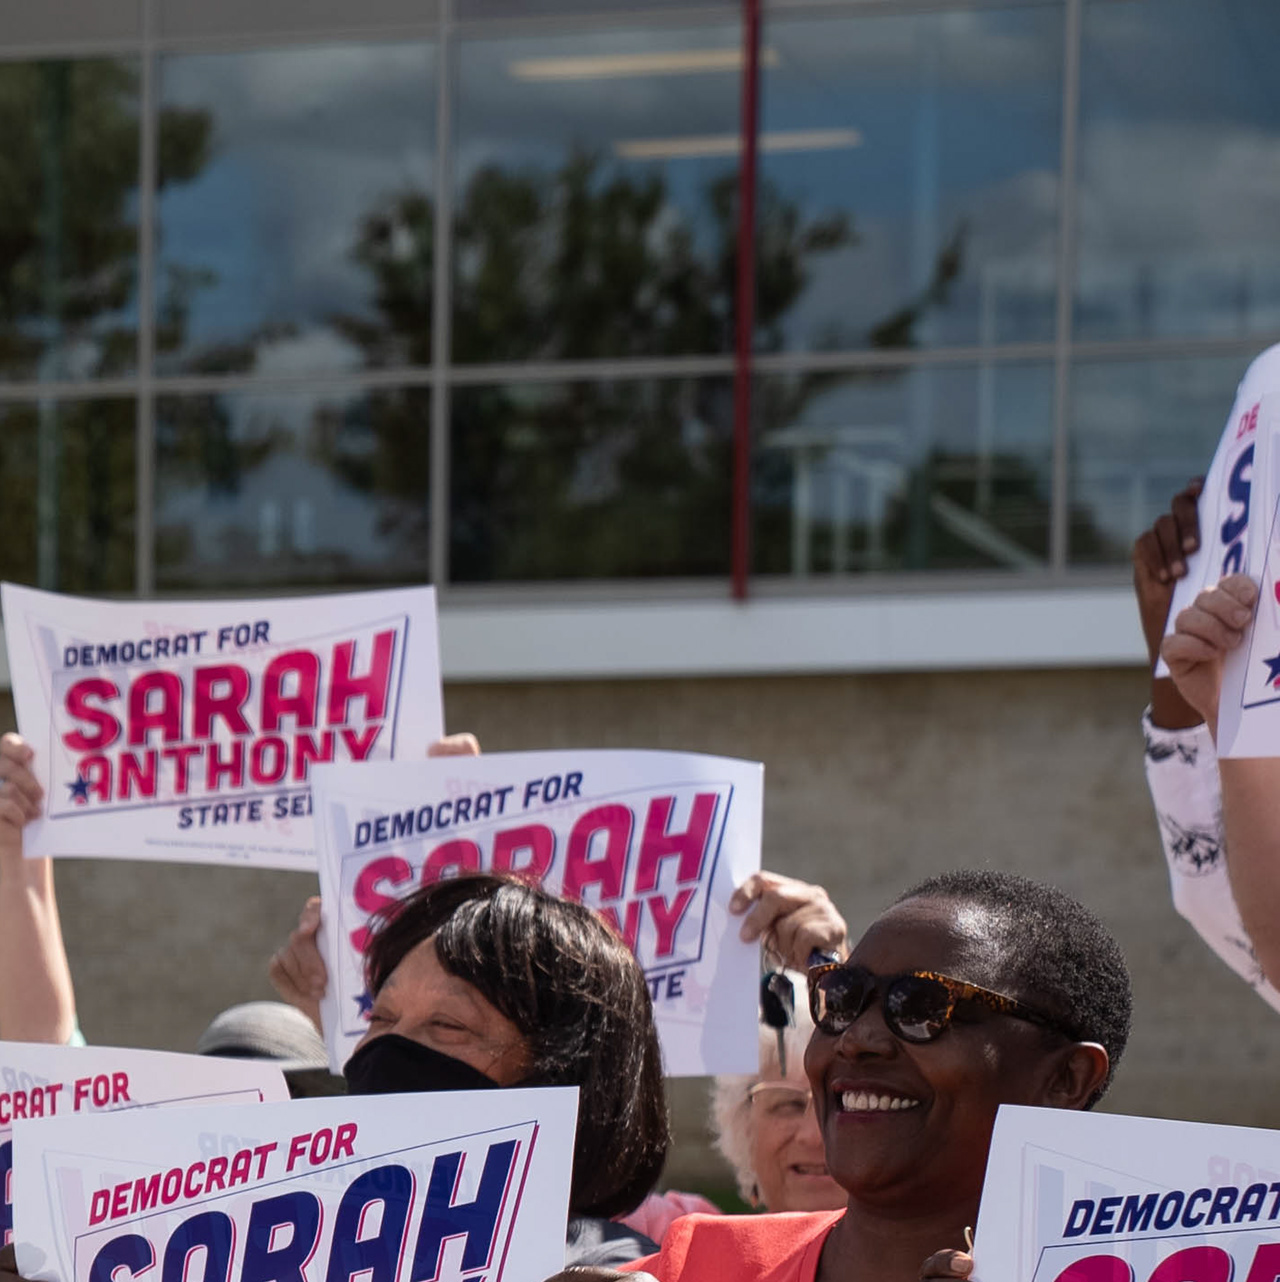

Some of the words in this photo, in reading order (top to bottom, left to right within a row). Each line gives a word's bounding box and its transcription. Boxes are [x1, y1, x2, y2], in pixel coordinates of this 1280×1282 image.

[63, 631, 207, 668] DEMOCRAT
[217, 620, 270, 650] FOR
[61, 629, 397, 752] SARAH
[74, 724, 383, 806] ANTHONY
[177, 800, 263, 829] STATE
[354, 787, 513, 848] DEMOCRAT
[523, 772, 584, 808] FOR
[73, 1072, 131, 1112] FOR
[89, 1142, 278, 1226] DEMOCRAT
[286, 1122, 359, 1173] FOR
